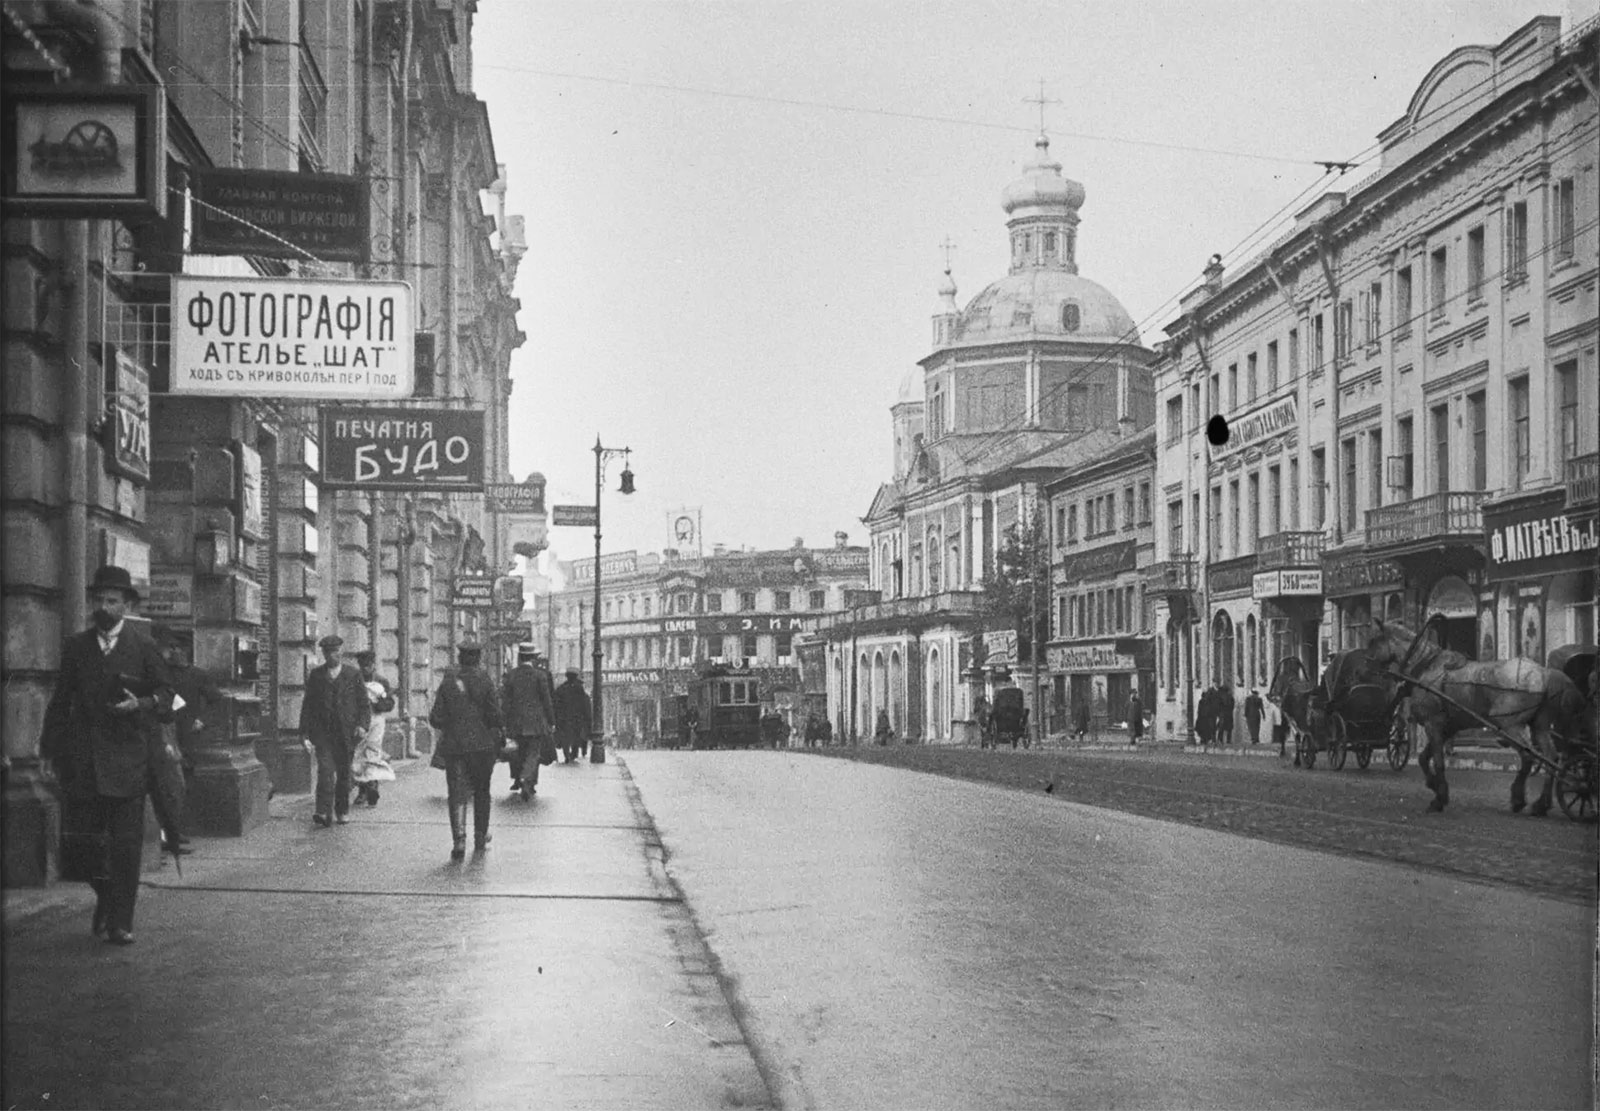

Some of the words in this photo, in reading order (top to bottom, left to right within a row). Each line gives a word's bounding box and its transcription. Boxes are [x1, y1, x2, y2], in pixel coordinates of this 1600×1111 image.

[187, 290, 395, 341] ФОТОГРАФІЯ
[203, 341, 308, 368] АТЕЛЬЕ
[188, 367, 223, 382] ХОДЪ
[226, 368, 245, 382] СЪ
[334, 419, 434, 440] ПЕЧАТНЯ
[355, 435, 470, 482] БУДО
